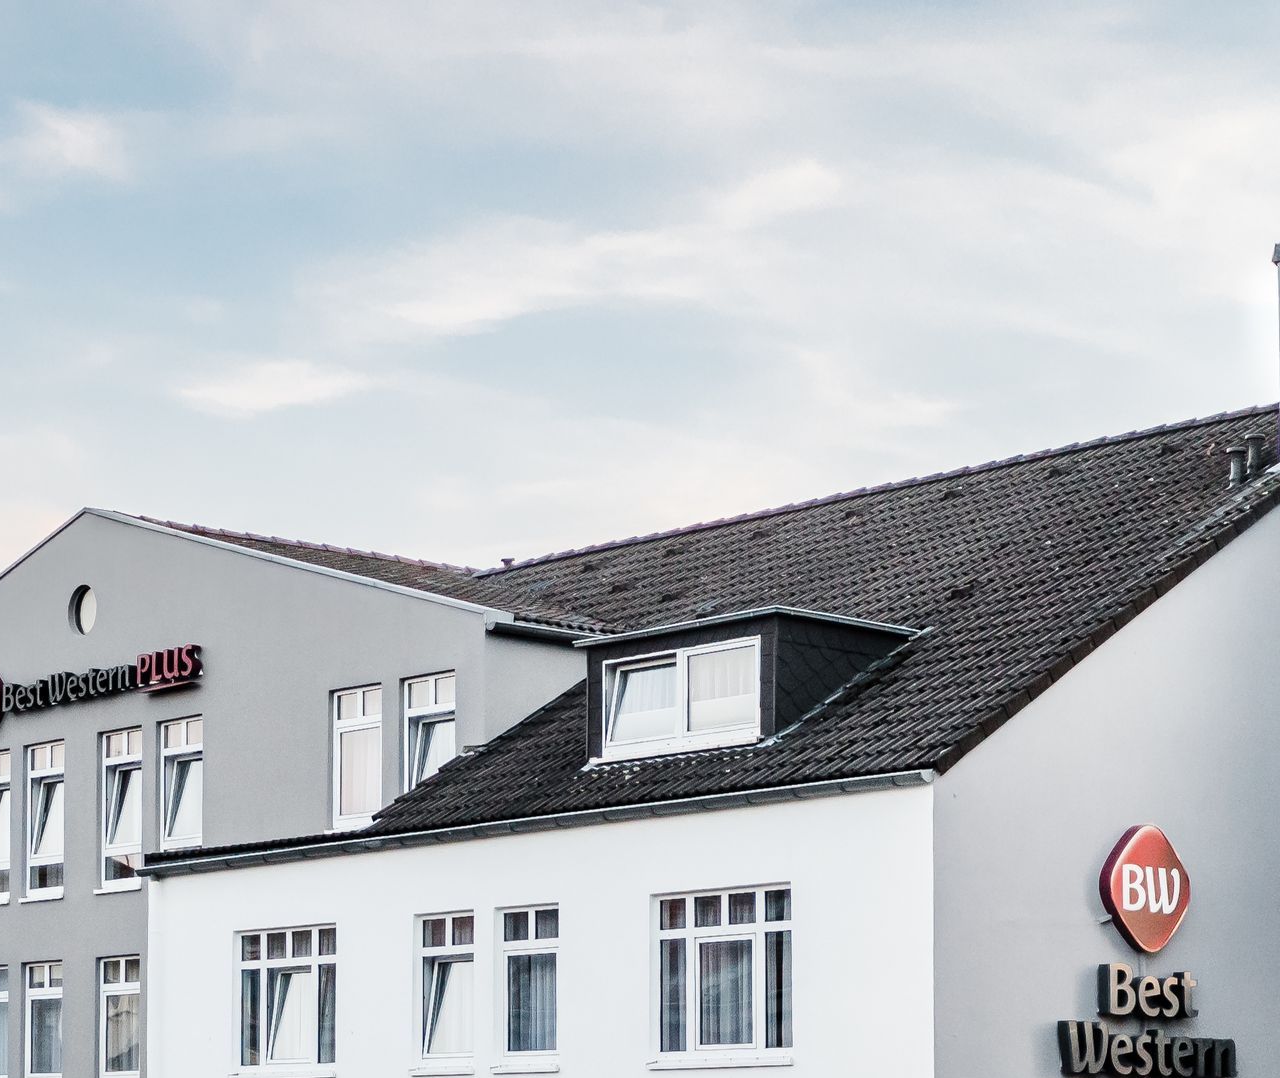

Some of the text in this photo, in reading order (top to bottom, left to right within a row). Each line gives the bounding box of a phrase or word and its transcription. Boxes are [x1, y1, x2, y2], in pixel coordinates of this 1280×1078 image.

[2, 643, 199, 712] Best Western PLUS
[1122, 864, 1180, 914] BW
[1100, 963, 1198, 1018] Best
[1060, 1021, 1237, 1077] Western
